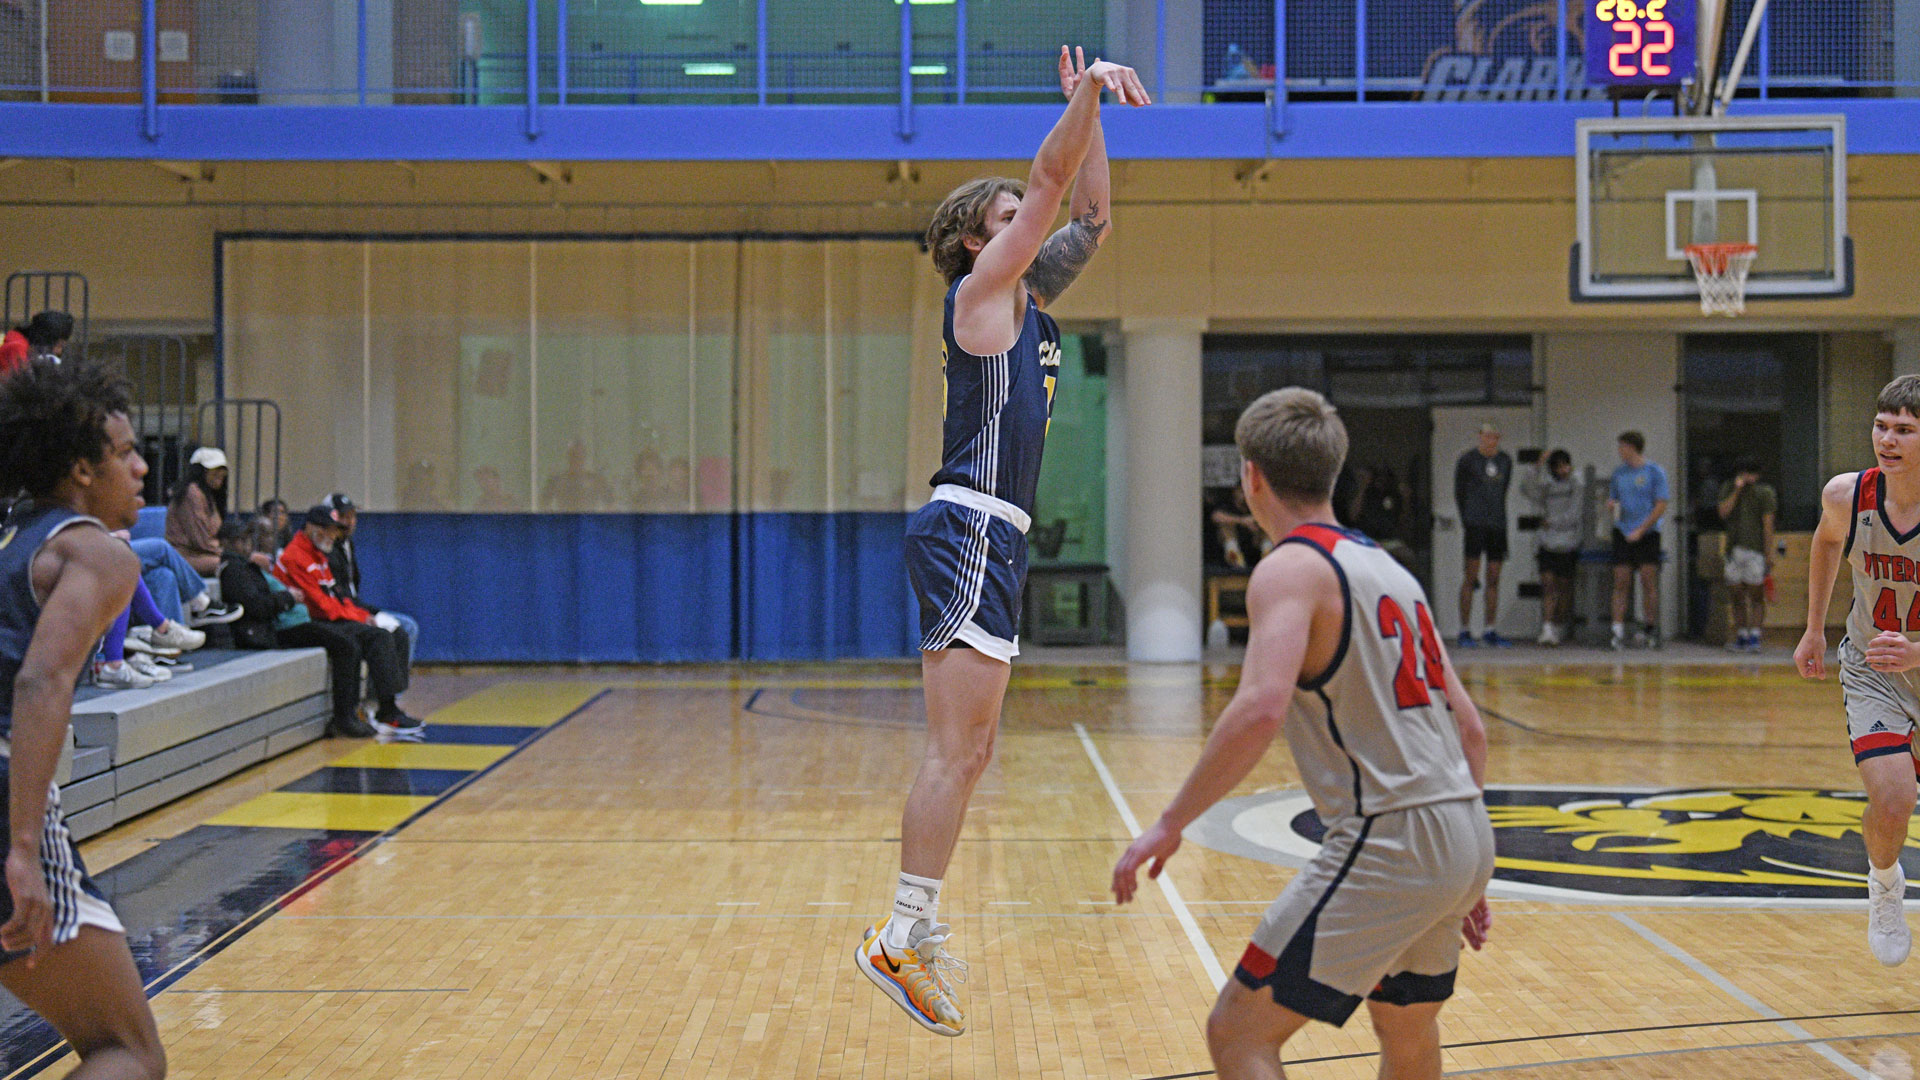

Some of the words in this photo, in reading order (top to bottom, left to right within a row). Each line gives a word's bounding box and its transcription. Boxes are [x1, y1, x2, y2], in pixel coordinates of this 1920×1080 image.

[1609, 20, 1675, 76] 22
[1421, 55, 1609, 101] CLARK
[1863, 550, 1920, 585] VITER
[1377, 594, 1453, 711] 24
